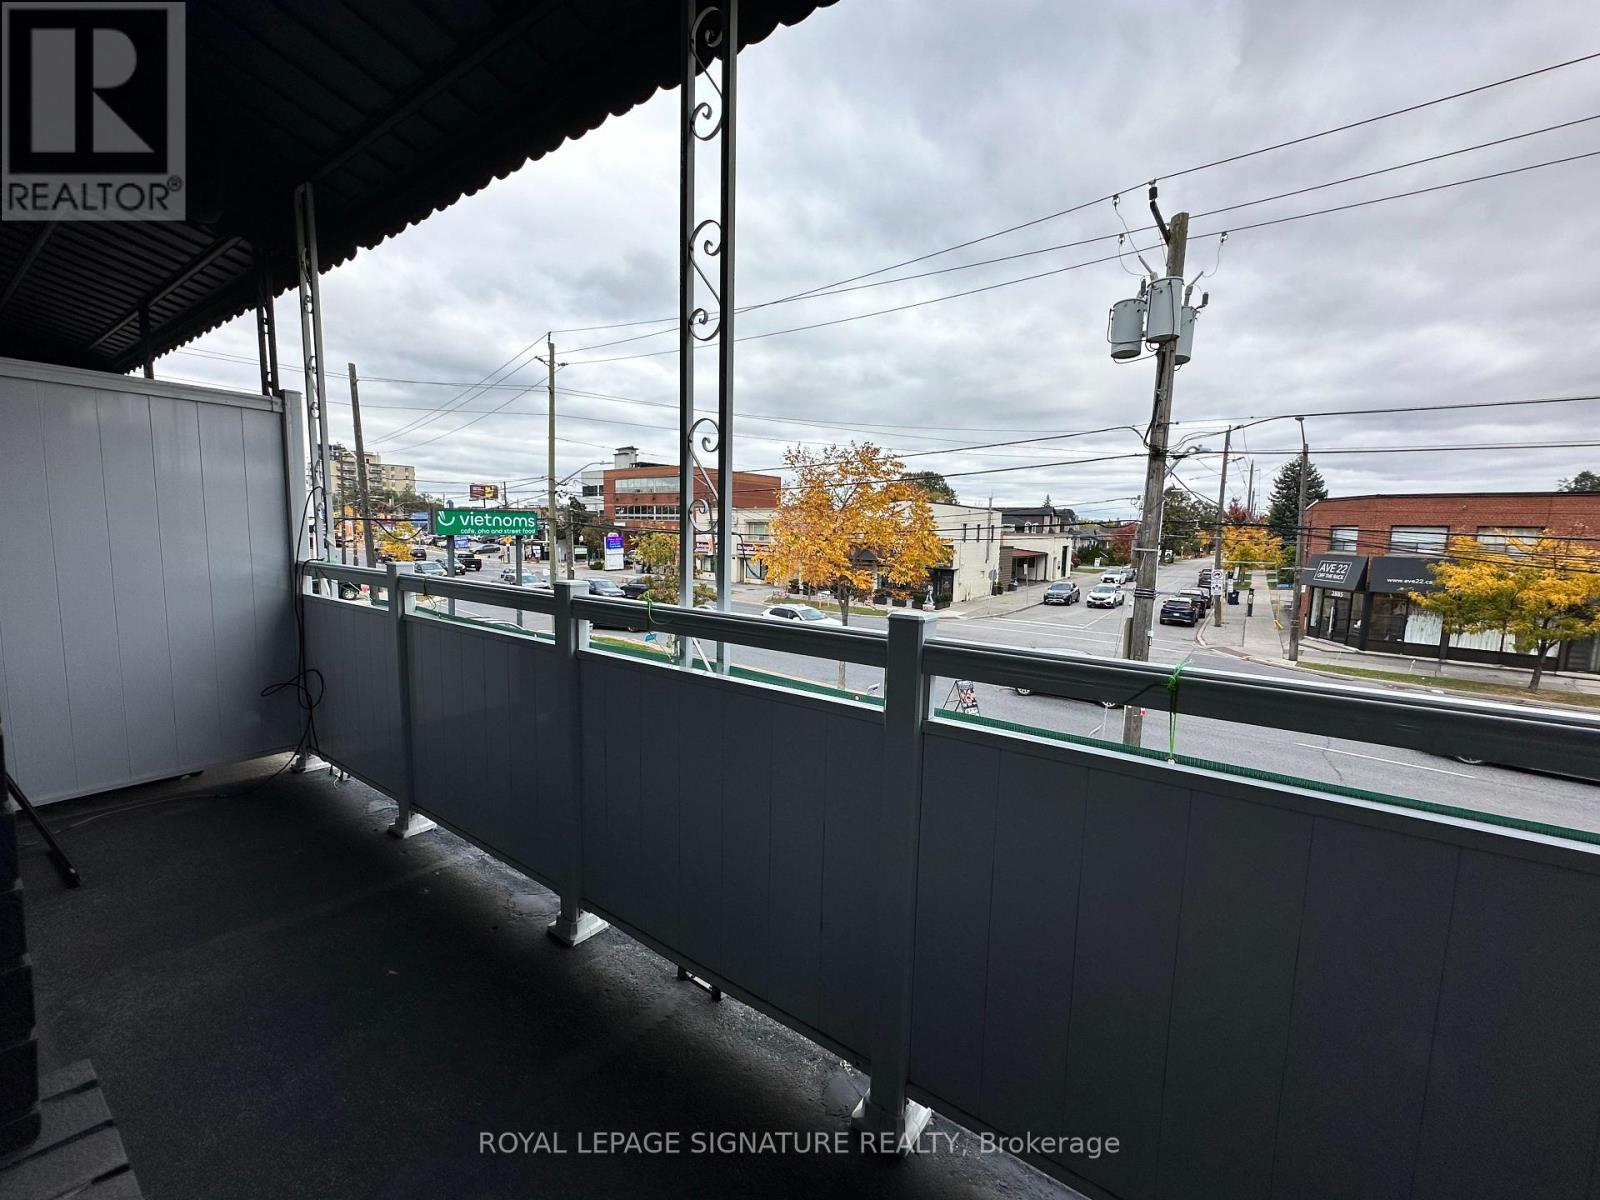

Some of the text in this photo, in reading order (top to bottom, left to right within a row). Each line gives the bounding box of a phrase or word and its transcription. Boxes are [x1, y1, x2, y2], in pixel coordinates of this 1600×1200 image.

[459, 511, 535, 527] vietnoms
[1318, 563, 1348, 574] AVE 22
